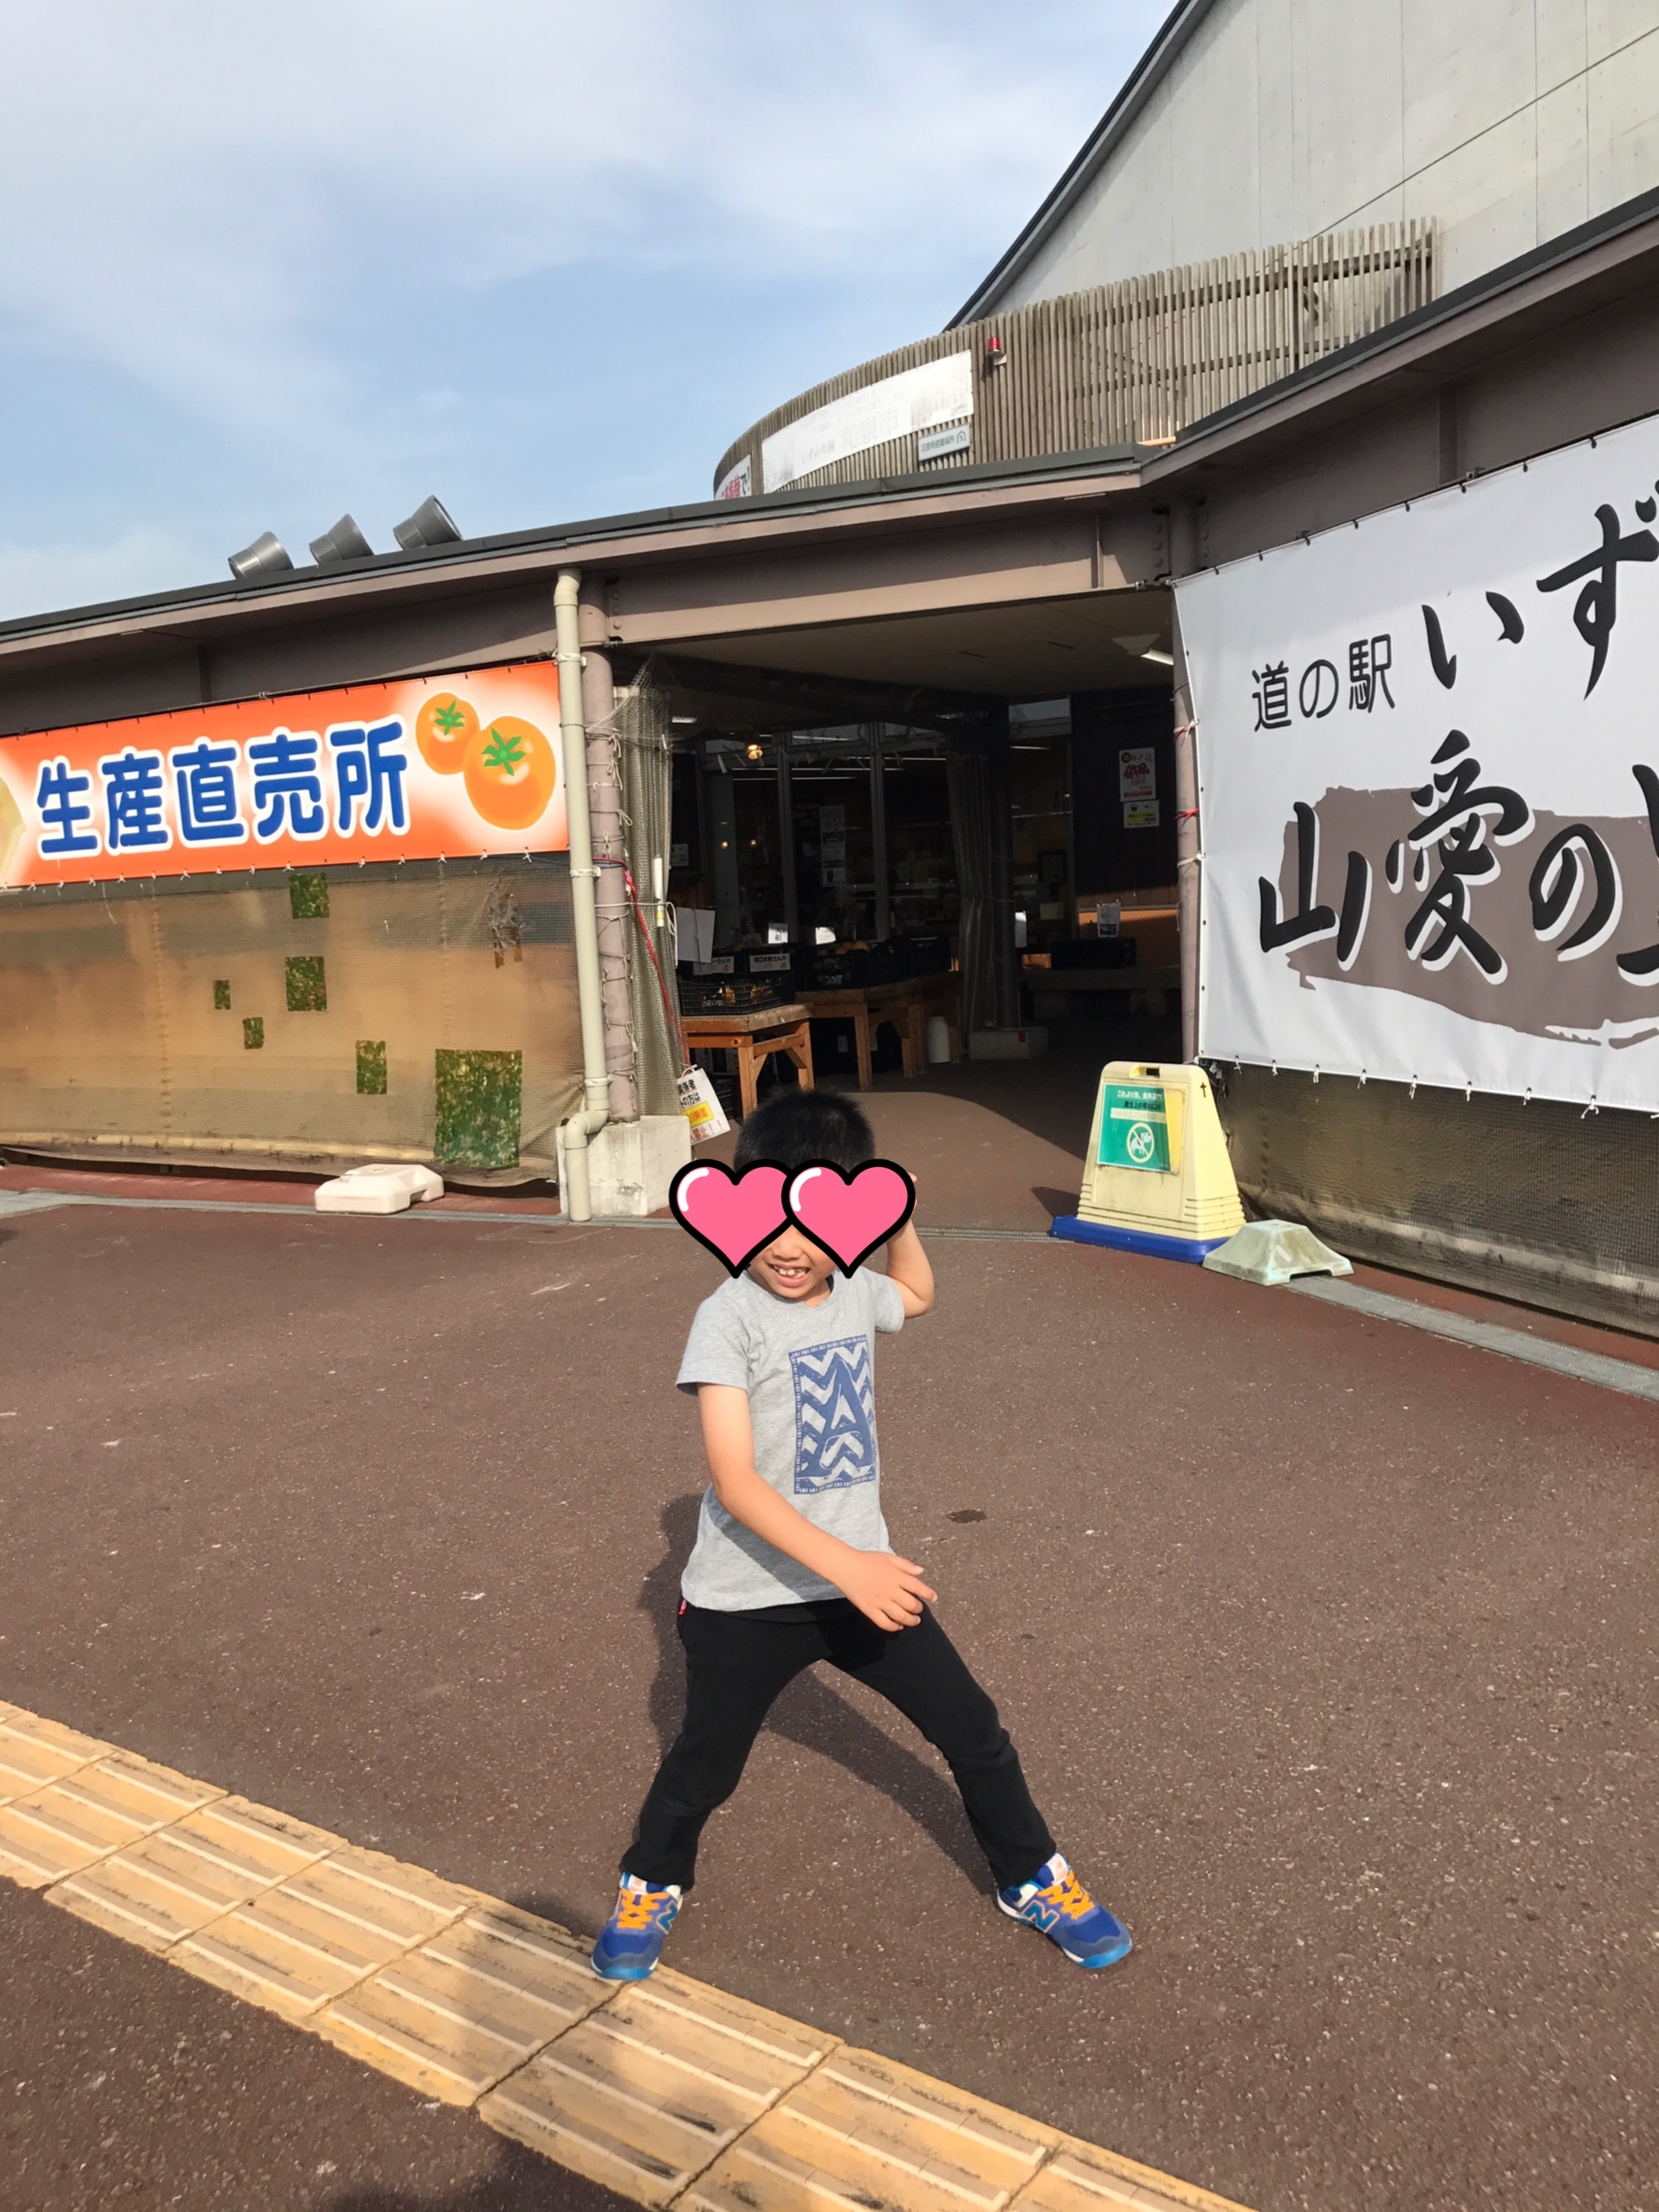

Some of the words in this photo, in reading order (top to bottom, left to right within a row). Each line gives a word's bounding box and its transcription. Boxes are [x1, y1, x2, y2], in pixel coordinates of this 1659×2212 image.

[1252, 632, 1396, 732] 道の駅
[36, 721, 409, 855] 生産直売所
